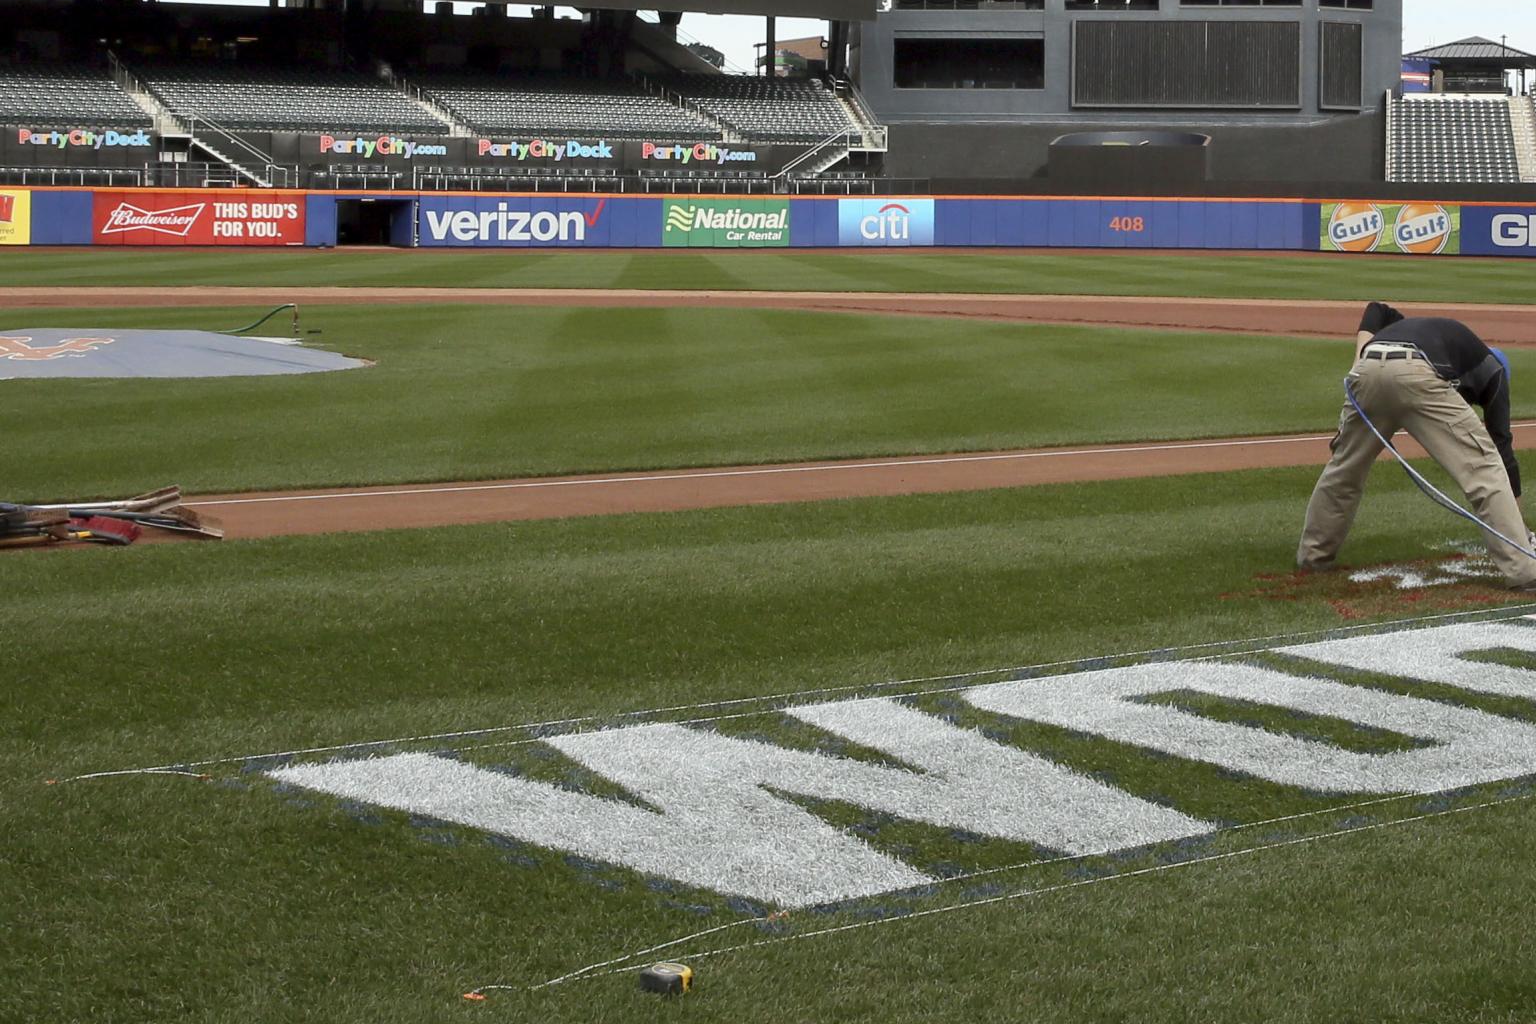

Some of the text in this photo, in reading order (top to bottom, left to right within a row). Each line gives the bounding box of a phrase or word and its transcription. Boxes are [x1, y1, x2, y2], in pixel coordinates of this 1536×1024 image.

[320, 135, 446, 159] PartyCity.com
[642, 142, 756, 164] PartyCity.com
[111, 209, 194, 226] Budweiser
[213, 202, 298, 218] THIS BUD'S
[213, 221, 282, 237] FOR YOU.
[426, 202, 585, 241] verizon
[860, 212, 908, 240] citi
[1109, 216, 1144, 233] 408
[1332, 214, 1379, 240] Gulf
[1398, 216, 1446, 242] Gulf
[726, 230, 782, 241] Car Rental
